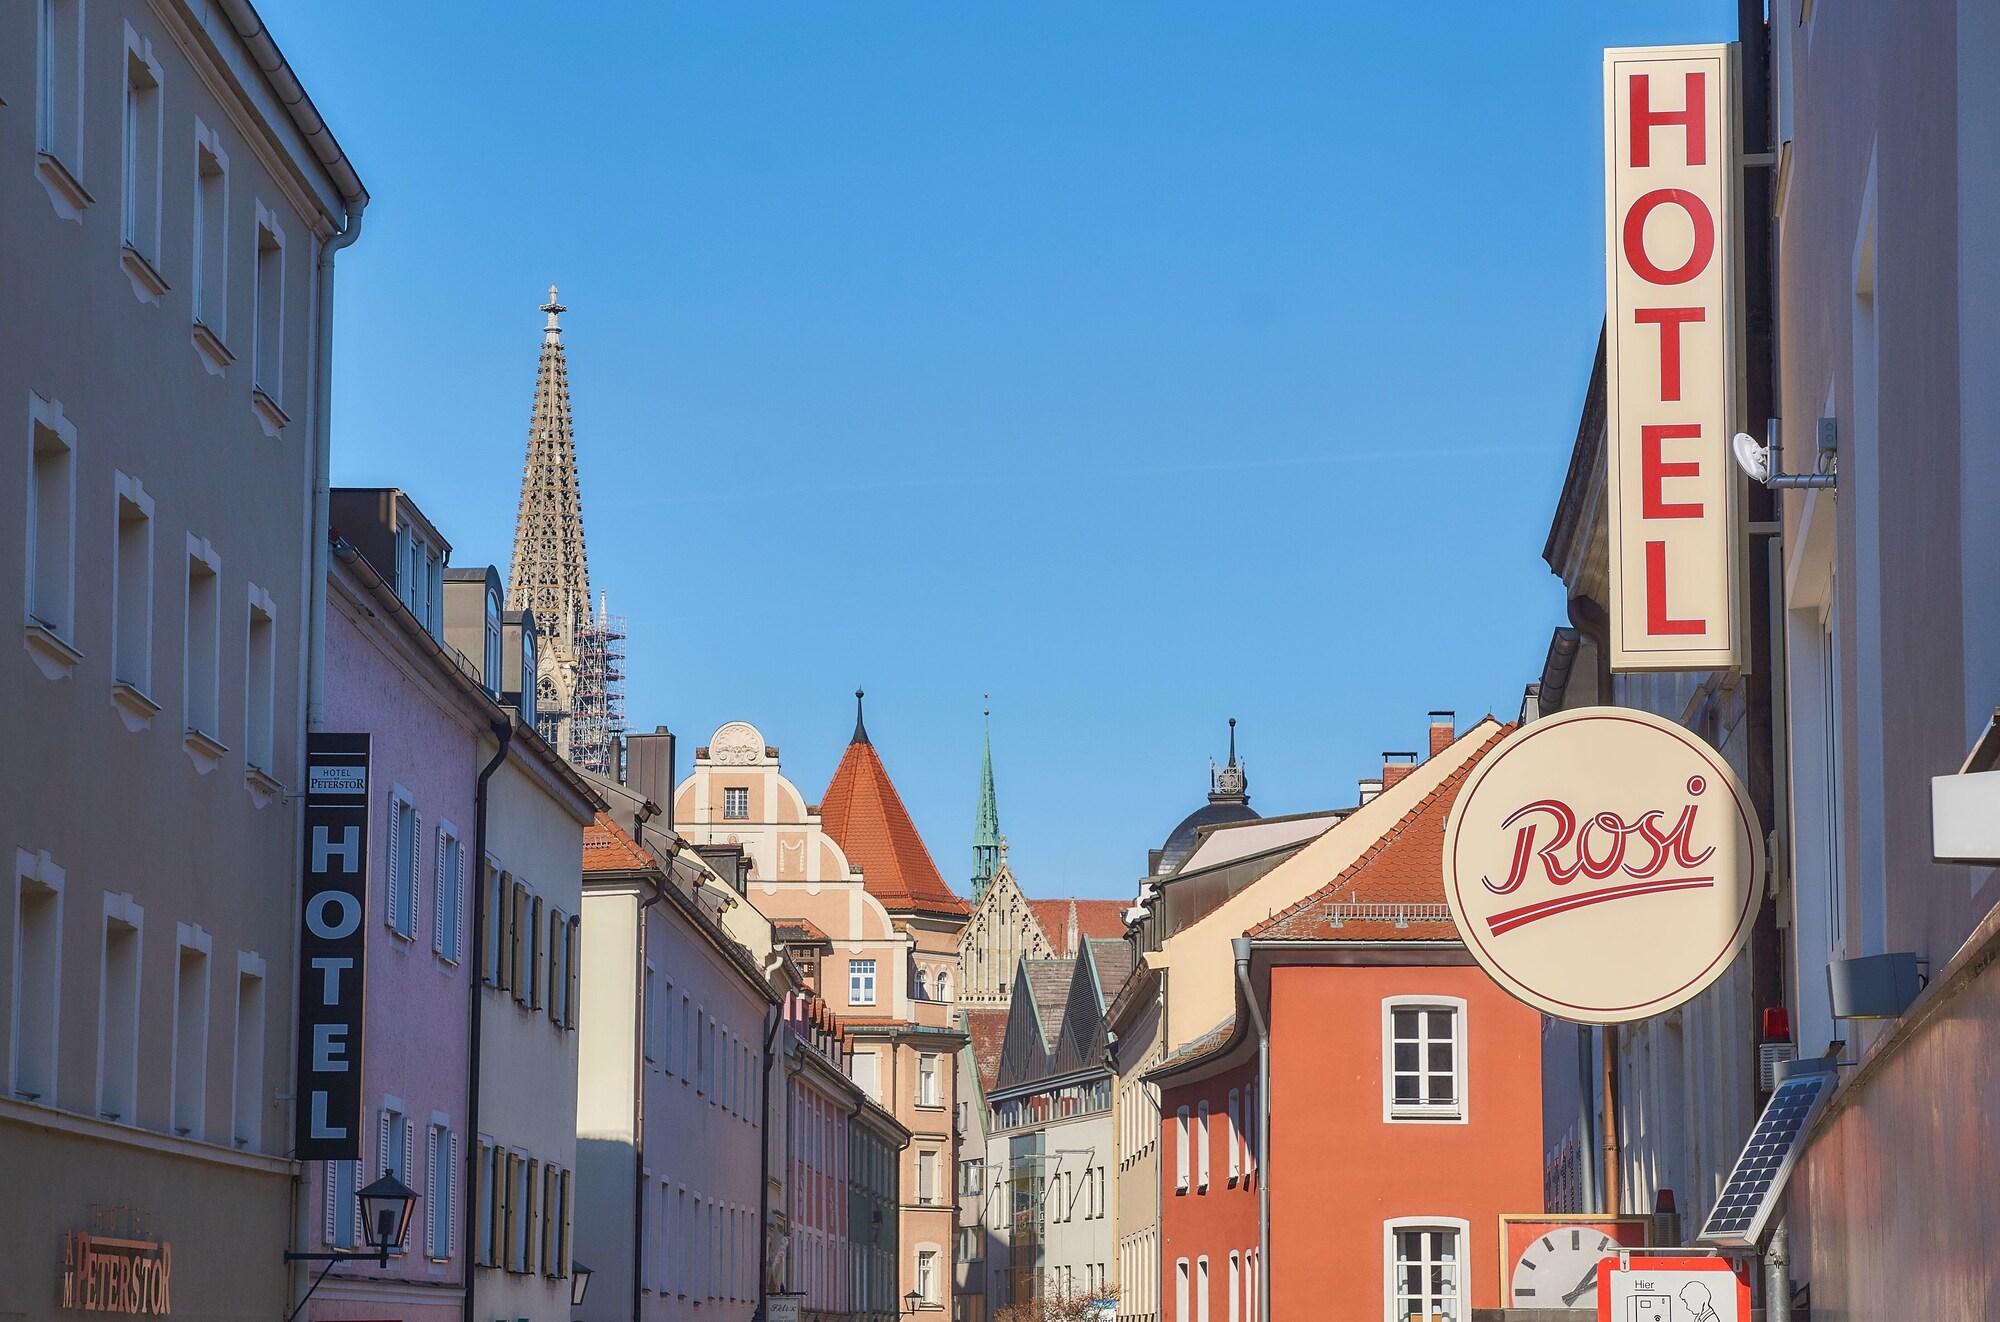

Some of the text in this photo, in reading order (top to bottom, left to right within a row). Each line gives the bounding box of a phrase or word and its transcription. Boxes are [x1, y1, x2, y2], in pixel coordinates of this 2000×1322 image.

[1623, 73, 1714, 635] HOTEL
[323, 769, 351, 777] HOTEL
[1482, 775, 1716, 895] Rosi
[306, 826, 361, 1139] HOTEL
[1634, 1280, 1655, 1289] Hier
